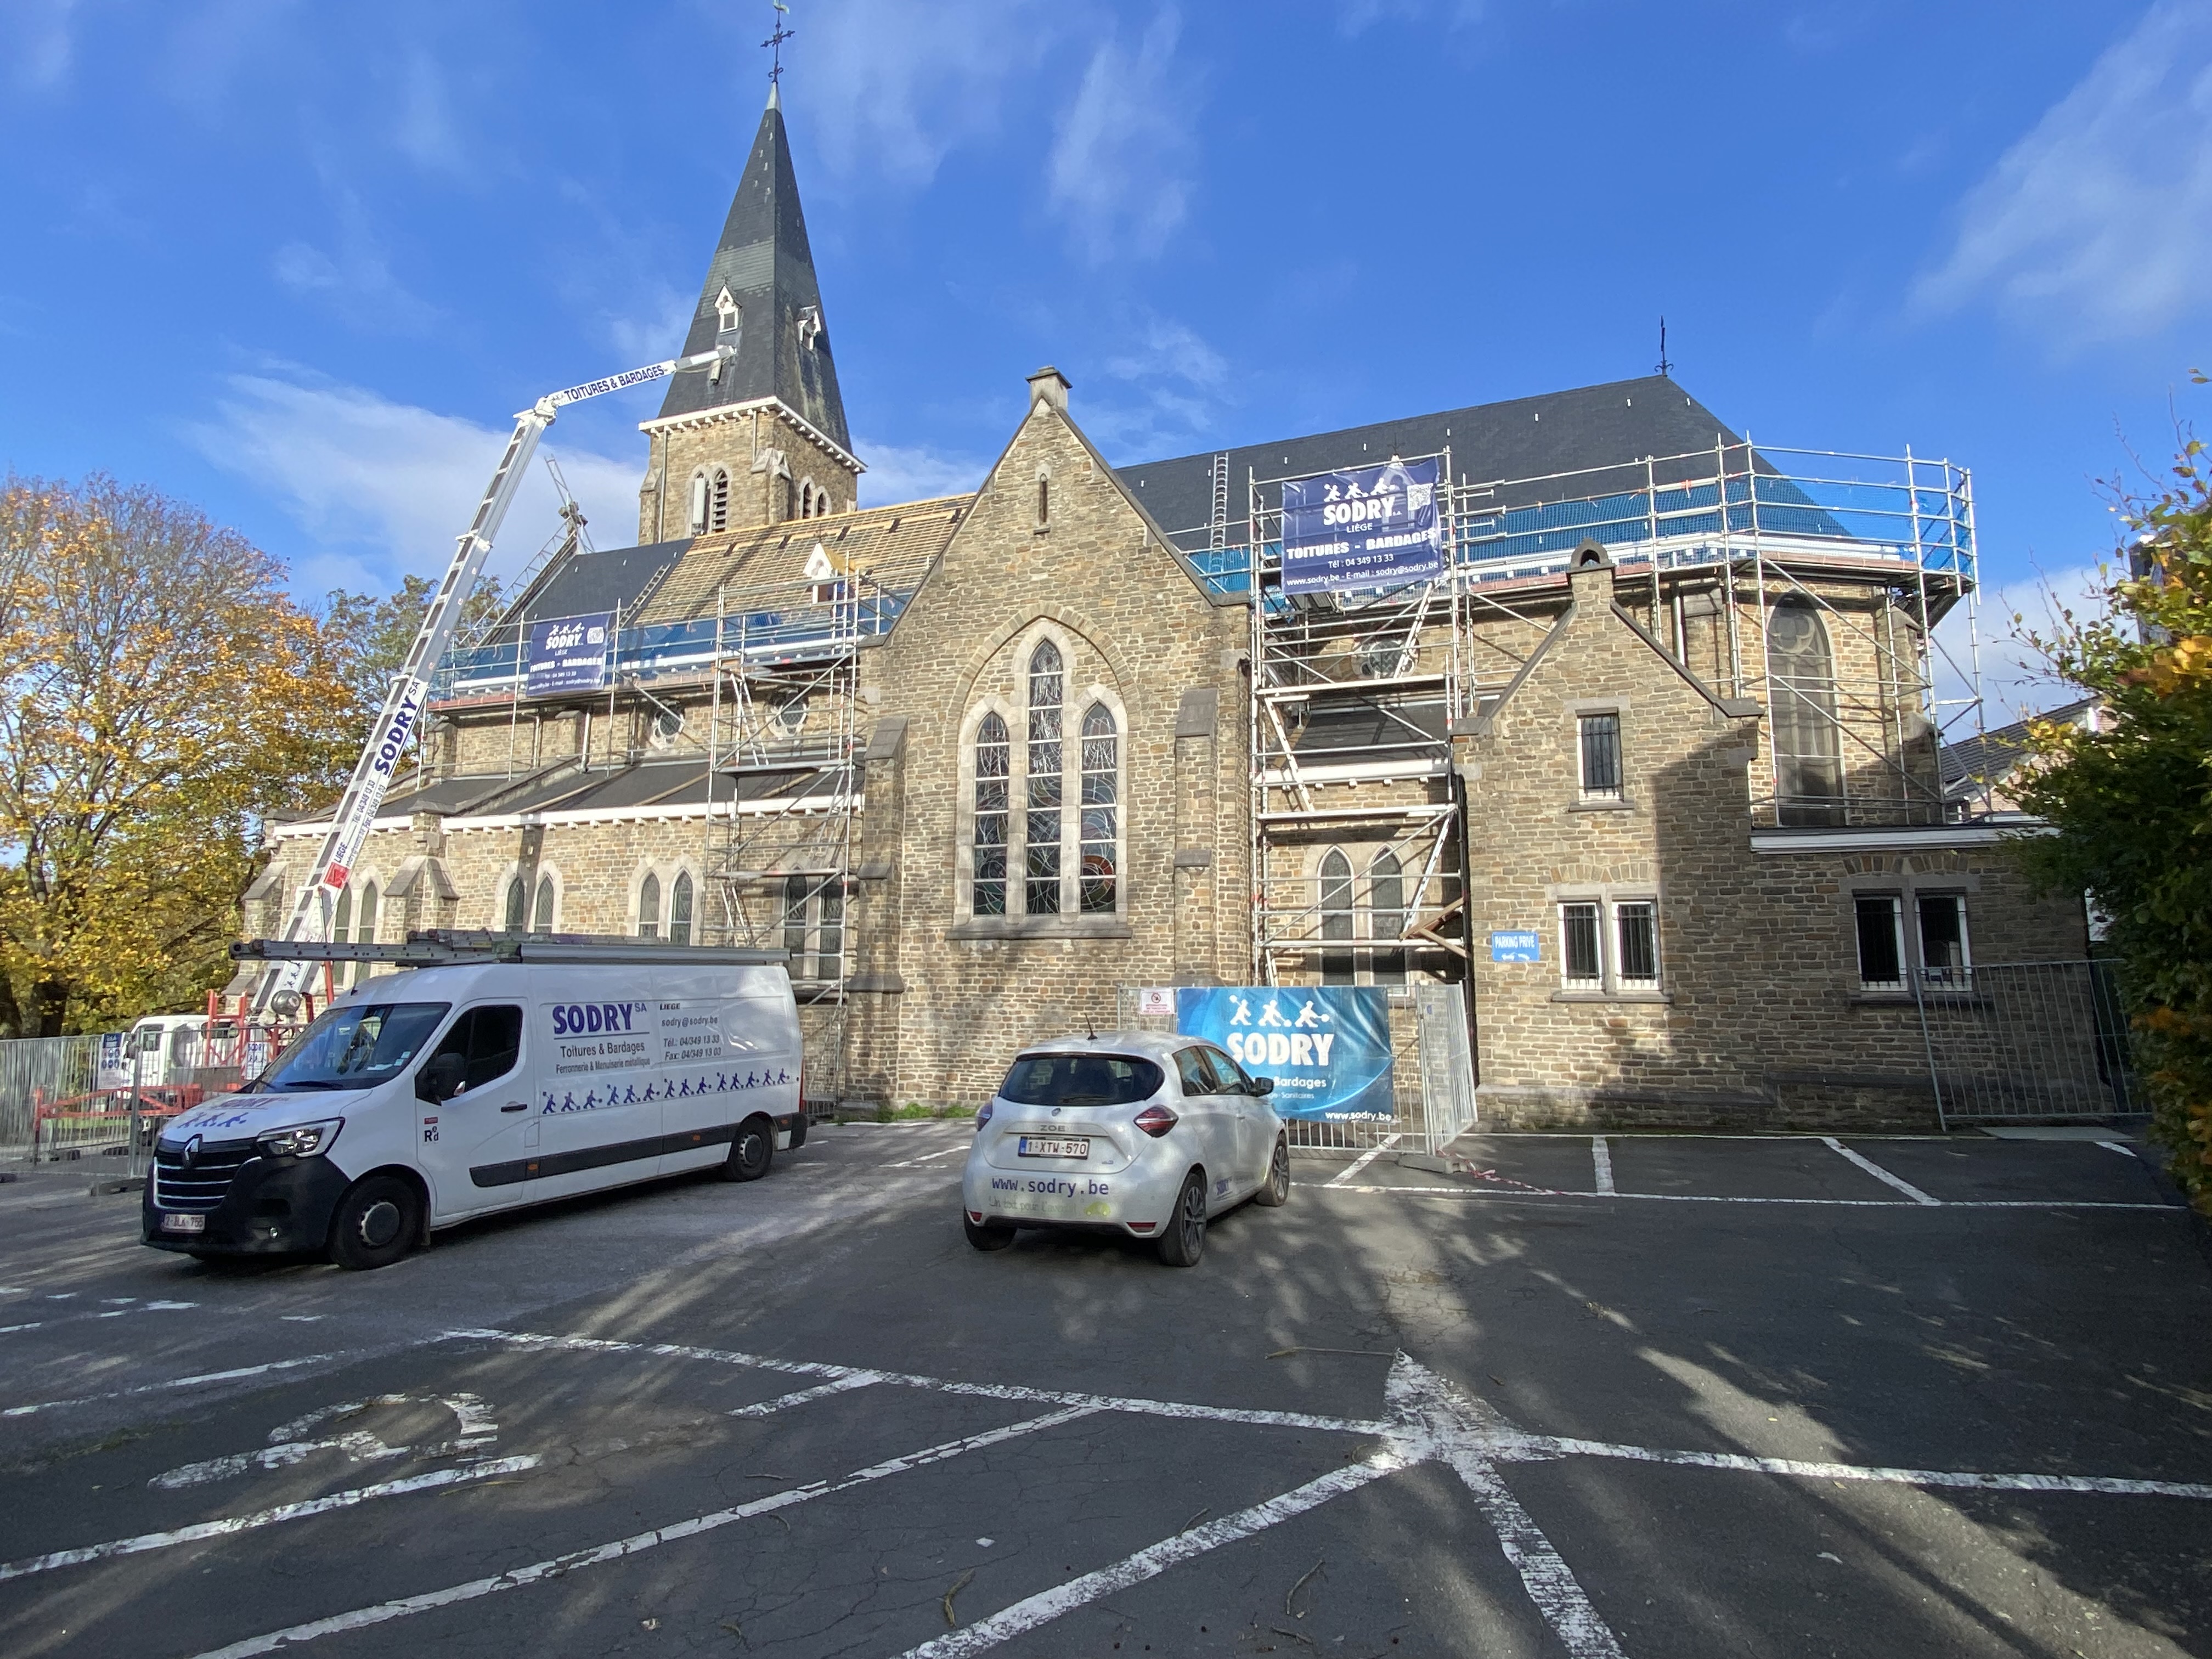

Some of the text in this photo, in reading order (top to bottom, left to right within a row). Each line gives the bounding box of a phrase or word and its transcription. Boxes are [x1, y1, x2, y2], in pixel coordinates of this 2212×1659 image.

[564, 381, 610, 401] TOITURES
[611, 378, 619, 388] &
[618, 365, 664, 386] BARDAGES
[1324, 496, 1396, 526] SODRY
[1346, 523, 1373, 533] LIÈGE
[1286, 542, 1350, 559] TOITURES
[1367, 527, 1437, 550] BARDAGES
[1357, 556, 1371, 565] 349
[1384, 554, 1394, 562] 33
[1286, 573, 1340, 586] www.sodry.be
[1346, 569, 1369, 579] E-mail
[1375, 561, 1438, 575] sodry@sodry.be
[545, 633, 583, 650] SODRY
[375, 681, 420, 775] SODRY SA
[334, 842, 348, 863] LIEGE
[1494, 936, 1518, 948] PARKING
[552, 1002, 647, 1034] SODRY SA
[662, 1015, 718, 1028] sodry@sodry.be
[680, 1036, 701, 1046] 04/349
[704, 1035, 710, 1044] 13
[712, 1034, 720, 1043] 33
[560, 1041, 645, 1058] Toitures & Bardages
[681, 1048, 703, 1059] 04/349
[713, 1047, 721, 1056] 03
[1227, 1032, 1334, 1066] SODRY
[556, 1062, 589, 1074] Ferronnerie
[590, 1061, 594, 1070] &
[595, 1059, 623, 1070] Menuiserie
[1274, 1076, 1327, 1090] Bardages
[1325, 1110, 1392, 1122] www.sodry.be
[992, 1178, 1109, 1198] www.sodry.be
